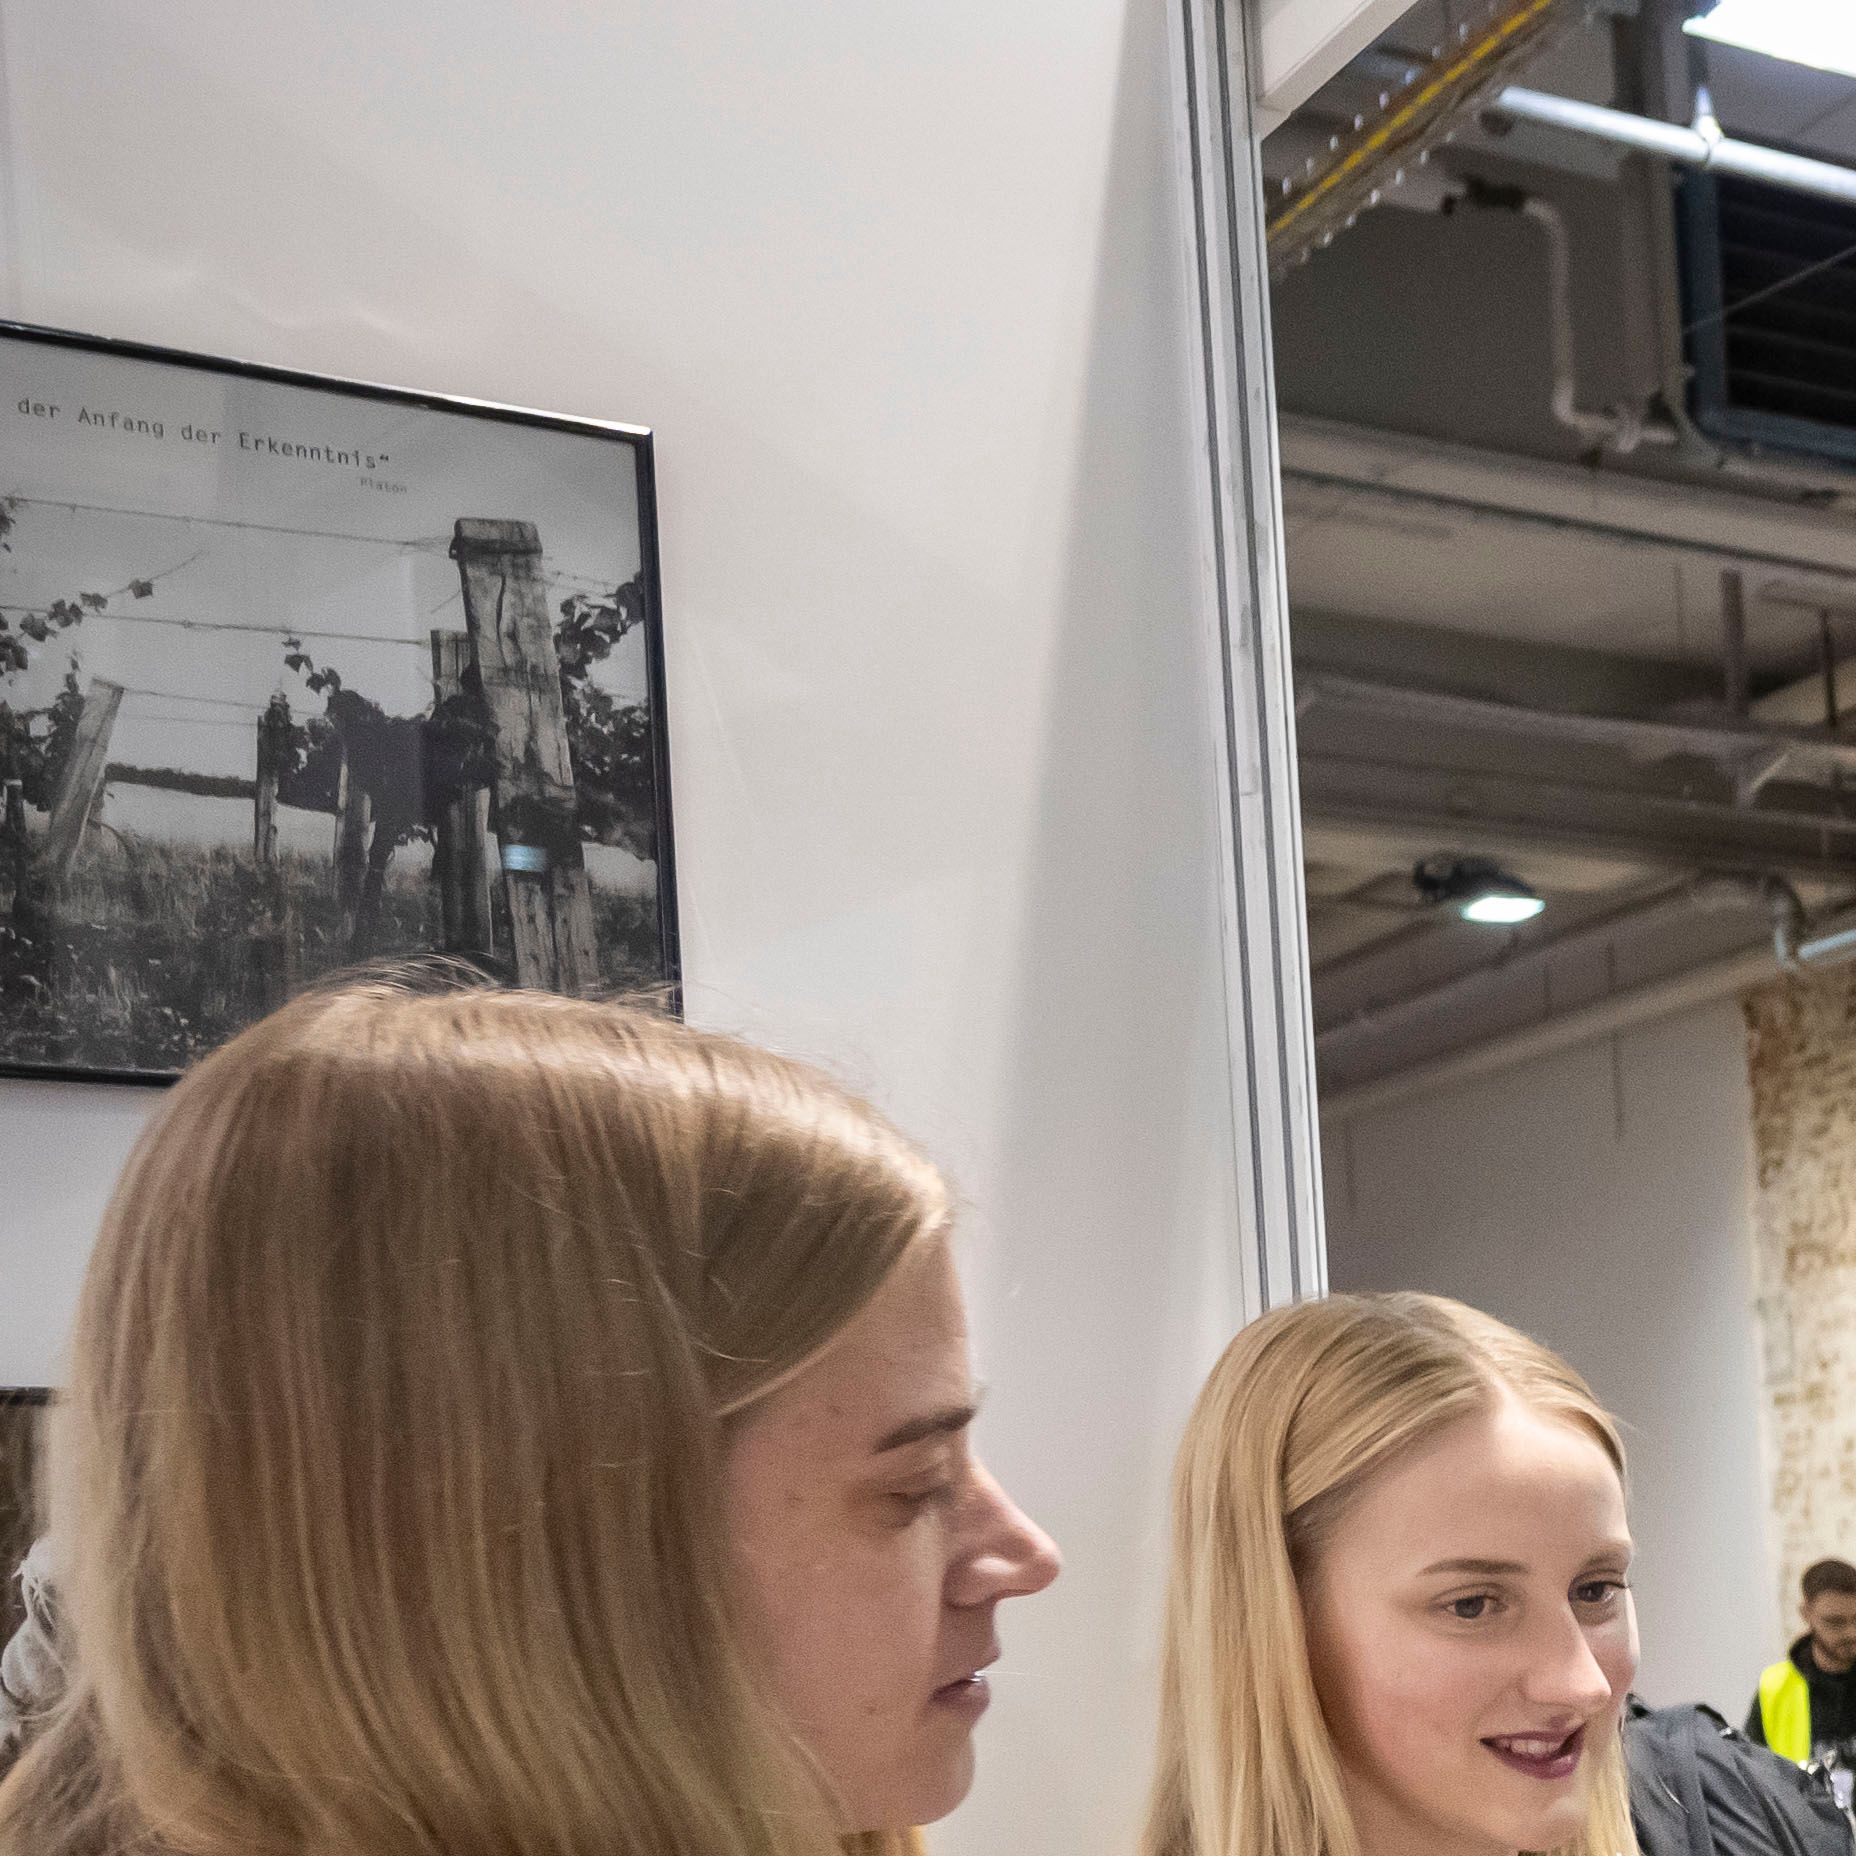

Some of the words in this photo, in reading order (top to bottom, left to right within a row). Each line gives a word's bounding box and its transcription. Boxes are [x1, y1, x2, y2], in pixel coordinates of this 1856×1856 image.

[17, 399, 61, 418] der
[77, 406, 165, 438] Anfang
[180, 425, 222, 445] der
[359, 477, 408, 495] Platon
